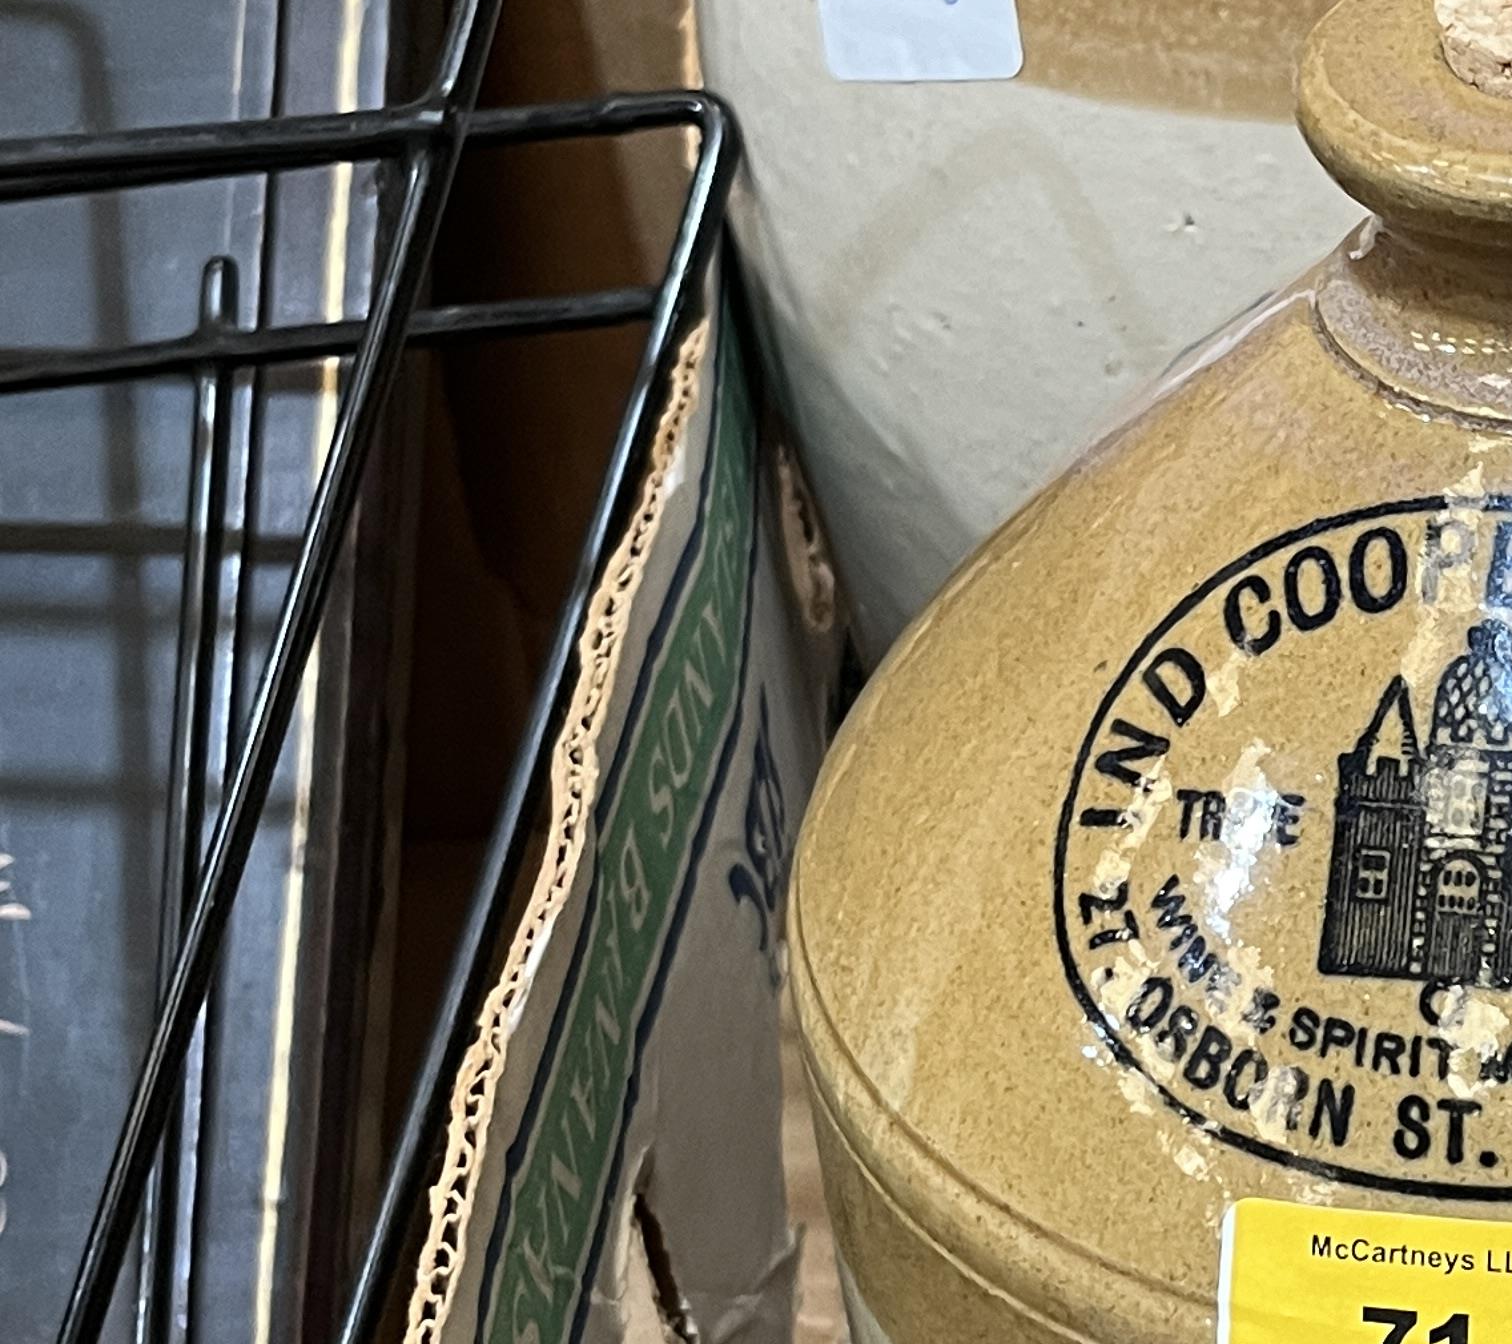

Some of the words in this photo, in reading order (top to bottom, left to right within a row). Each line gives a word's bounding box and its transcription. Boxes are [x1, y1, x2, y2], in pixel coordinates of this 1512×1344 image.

[1079, 647, 1207, 828] IND
[1176, 788, 1306, 847] TRE
[1242, 986, 1281, 1035] &
[1289, 1006, 1458, 1082] SPIRIT
[1393, 1093, 1499, 1169] ST.
[1310, 1233, 1475, 1275] McCartneys
